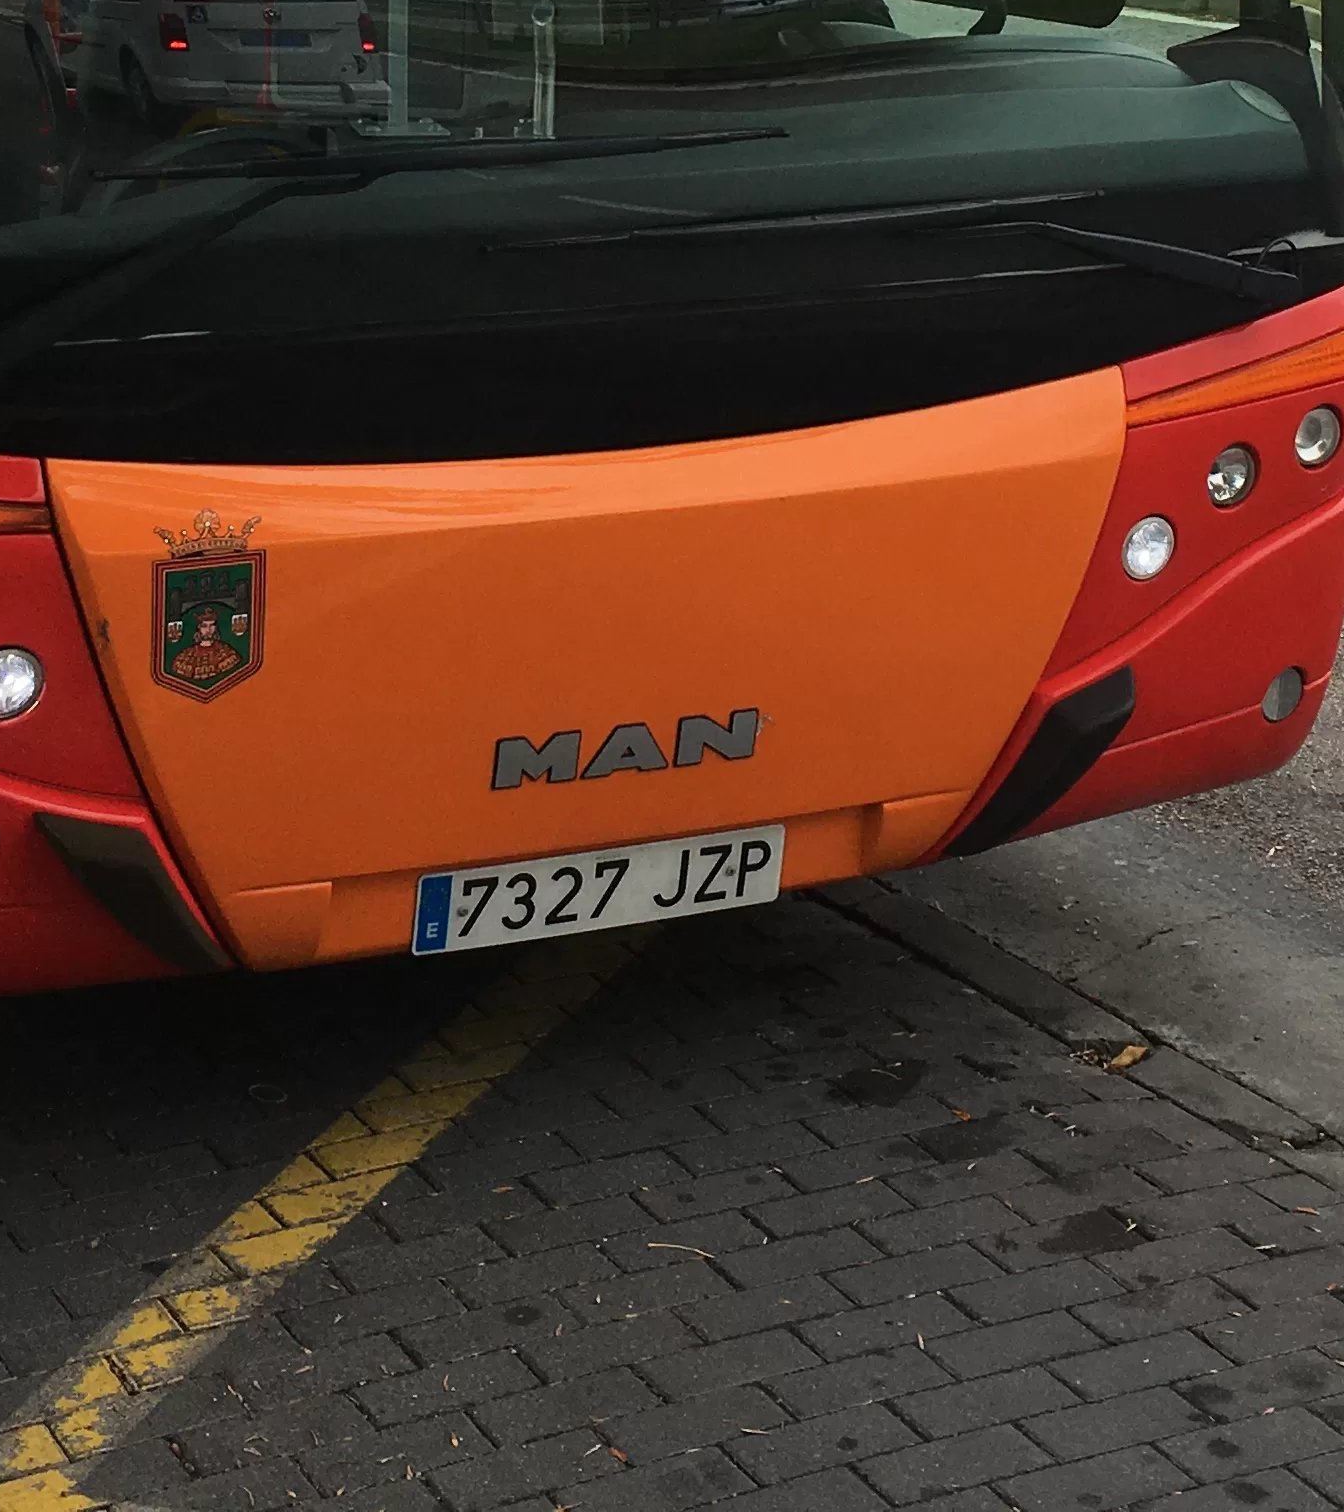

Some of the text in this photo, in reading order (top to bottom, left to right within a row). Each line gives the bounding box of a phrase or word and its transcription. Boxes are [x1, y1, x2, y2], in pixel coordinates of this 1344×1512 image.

[491, 707, 759, 791] MAN
[425, 840, 773, 939] E 7327 JZP
